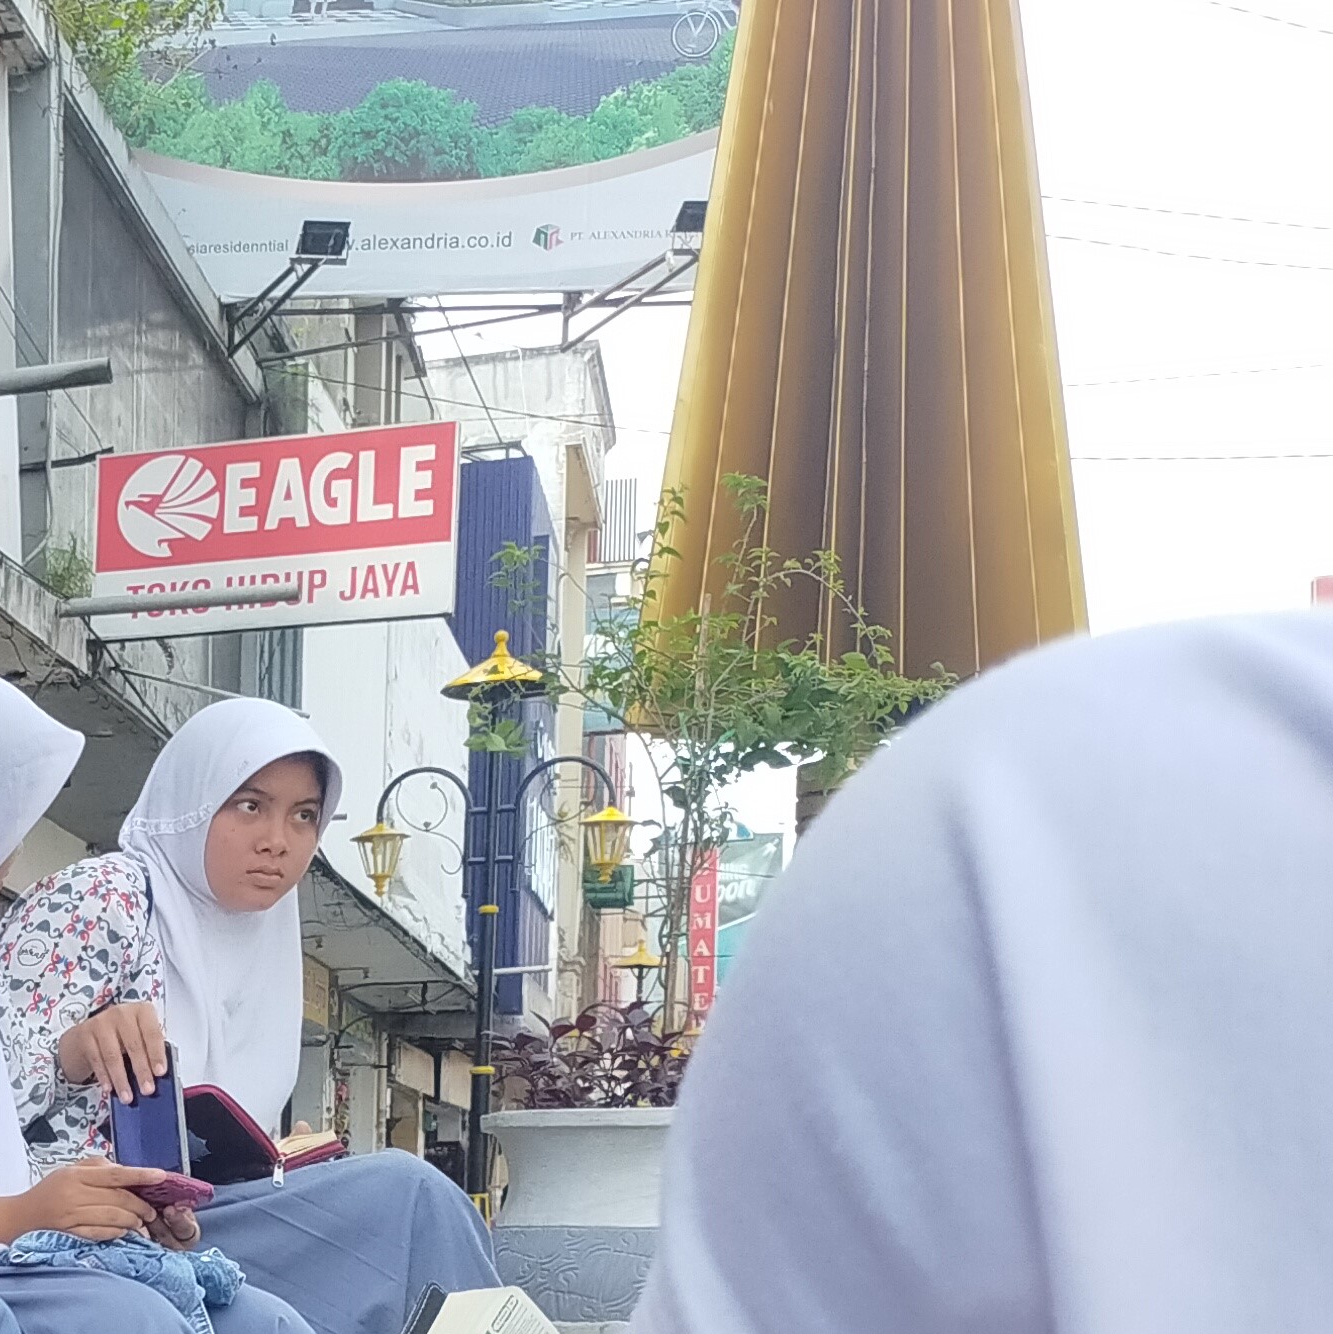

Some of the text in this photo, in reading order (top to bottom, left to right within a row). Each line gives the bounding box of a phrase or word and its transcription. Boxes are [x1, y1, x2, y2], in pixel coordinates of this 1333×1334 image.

[588, 229, 662, 240] ALEXANDRIA
[223, 444, 437, 535] EAGLE
[339, 561, 420, 602] JAYA
